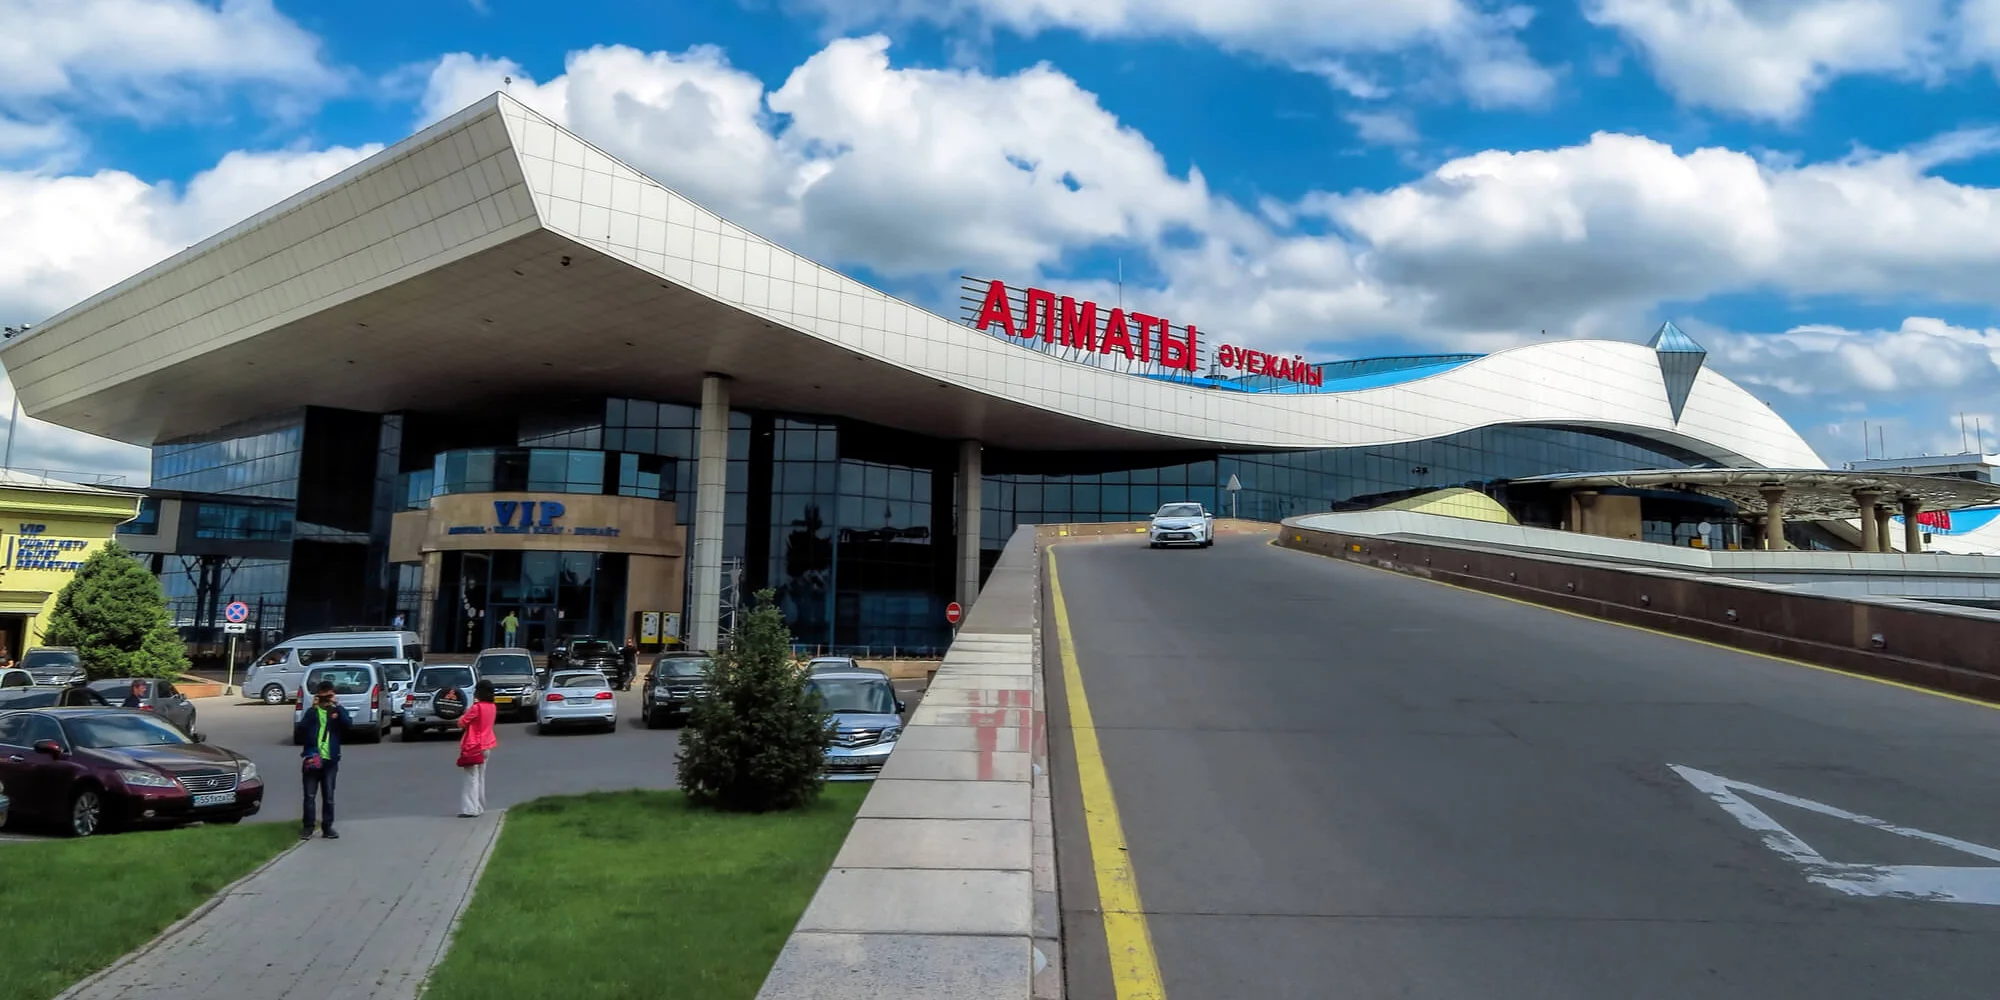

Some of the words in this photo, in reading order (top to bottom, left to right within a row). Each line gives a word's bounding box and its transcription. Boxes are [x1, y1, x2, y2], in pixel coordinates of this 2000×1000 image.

[976, 280, 1197, 372] АЛМАТЫ
[1219, 344, 1323, 387] ӘУЕЖАЙЫ
[493, 501, 565, 527] VIP
[20, 523, 47, 535] VIP
